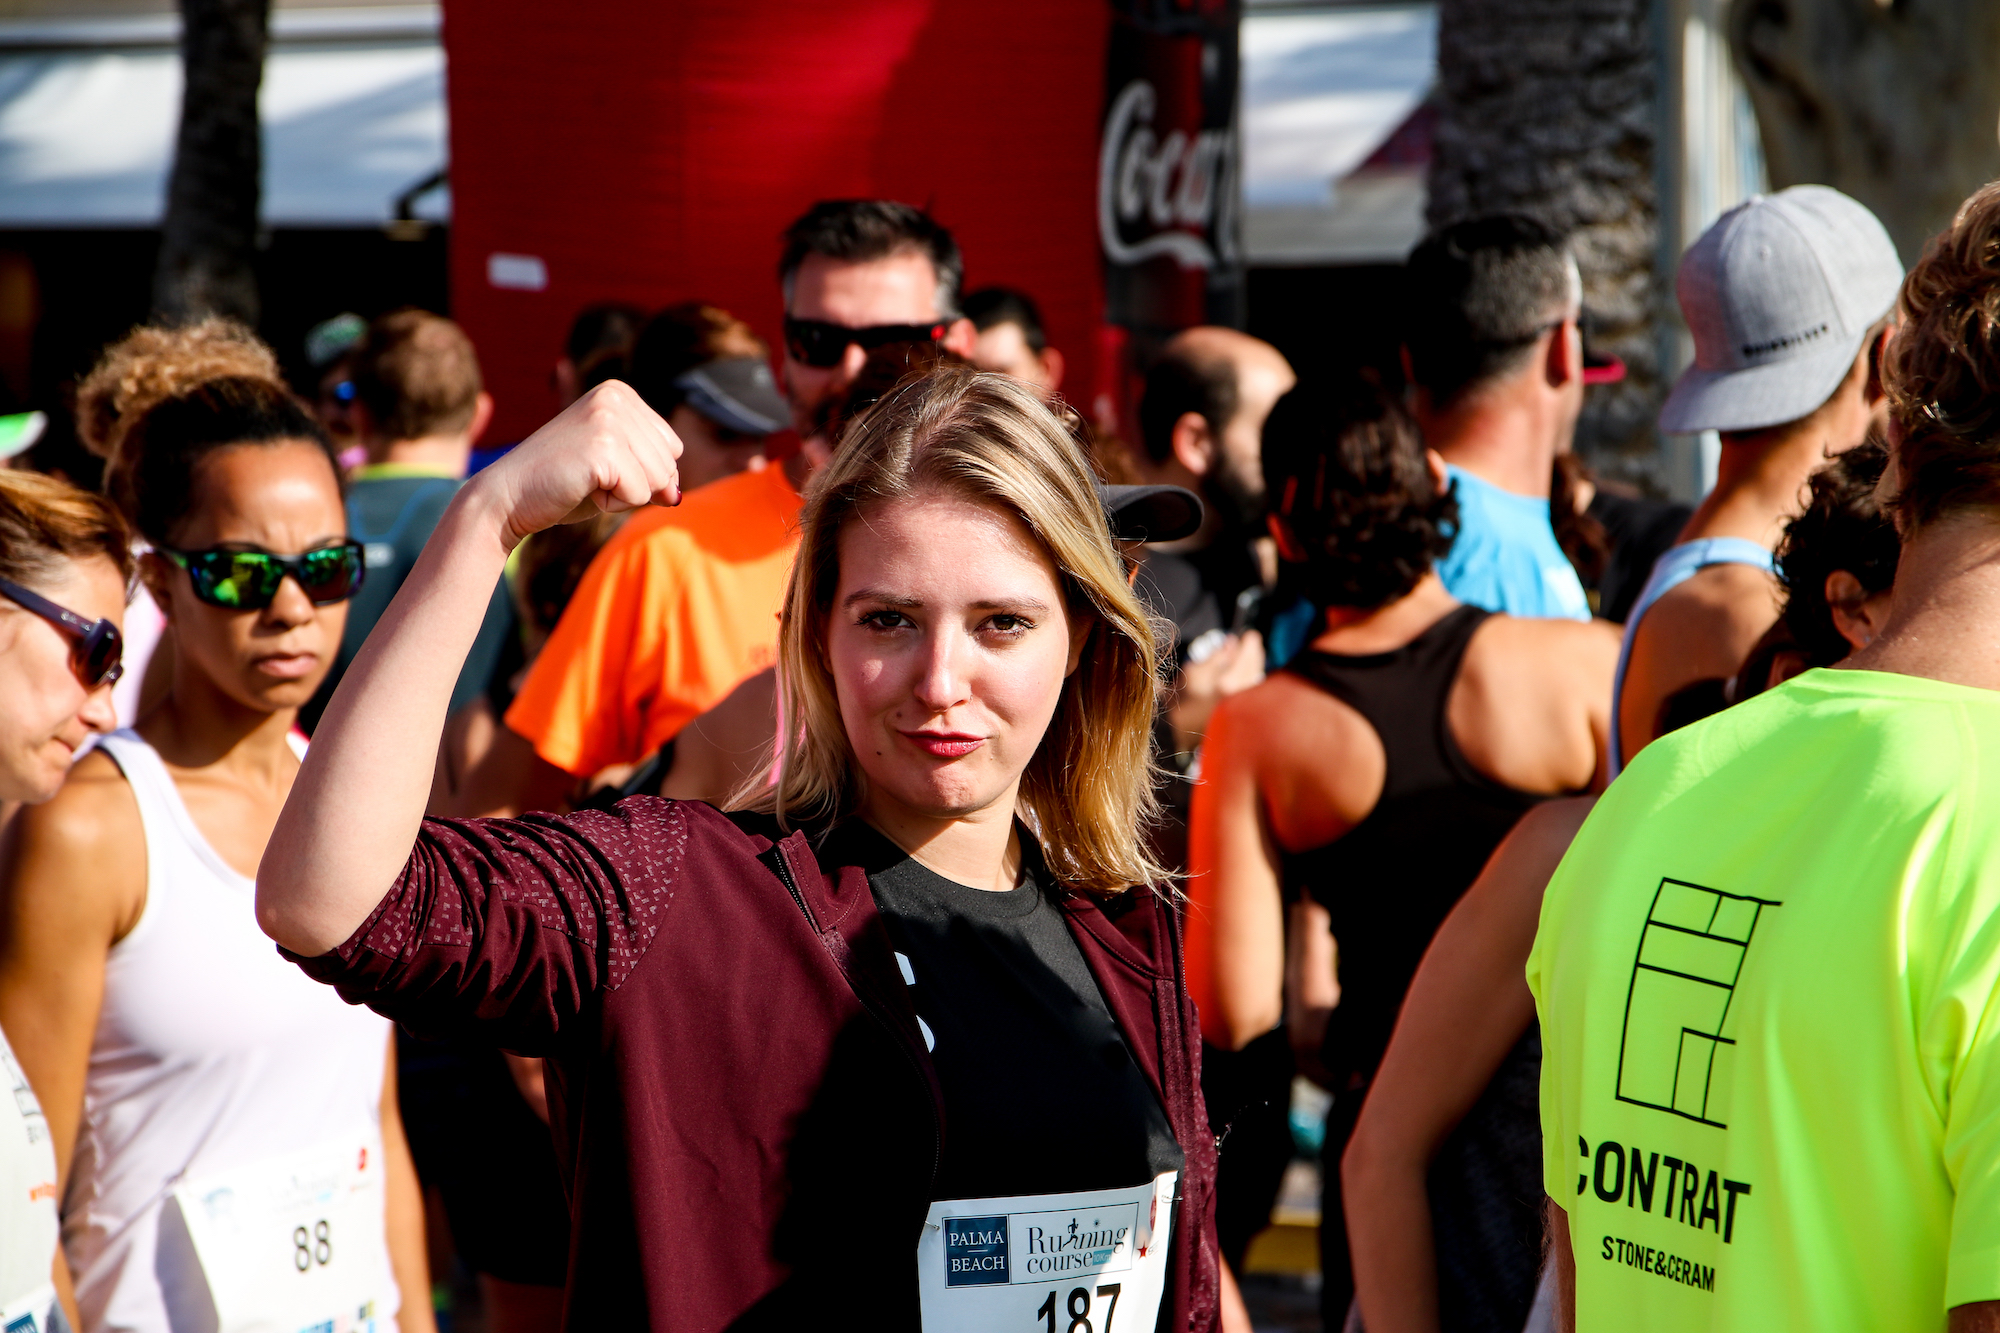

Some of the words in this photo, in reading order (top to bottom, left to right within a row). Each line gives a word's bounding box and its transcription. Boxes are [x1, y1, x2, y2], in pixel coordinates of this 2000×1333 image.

[293, 1219, 333, 1273] 88
[949, 1231, 1004, 1247] PALMA
[951, 1256, 1005, 1272] BEACH
[1027, 1251, 1093, 1274] course
[1601, 1235, 1715, 1293] STONE&CERAM
[1037, 1283, 1121, 1333] 187
